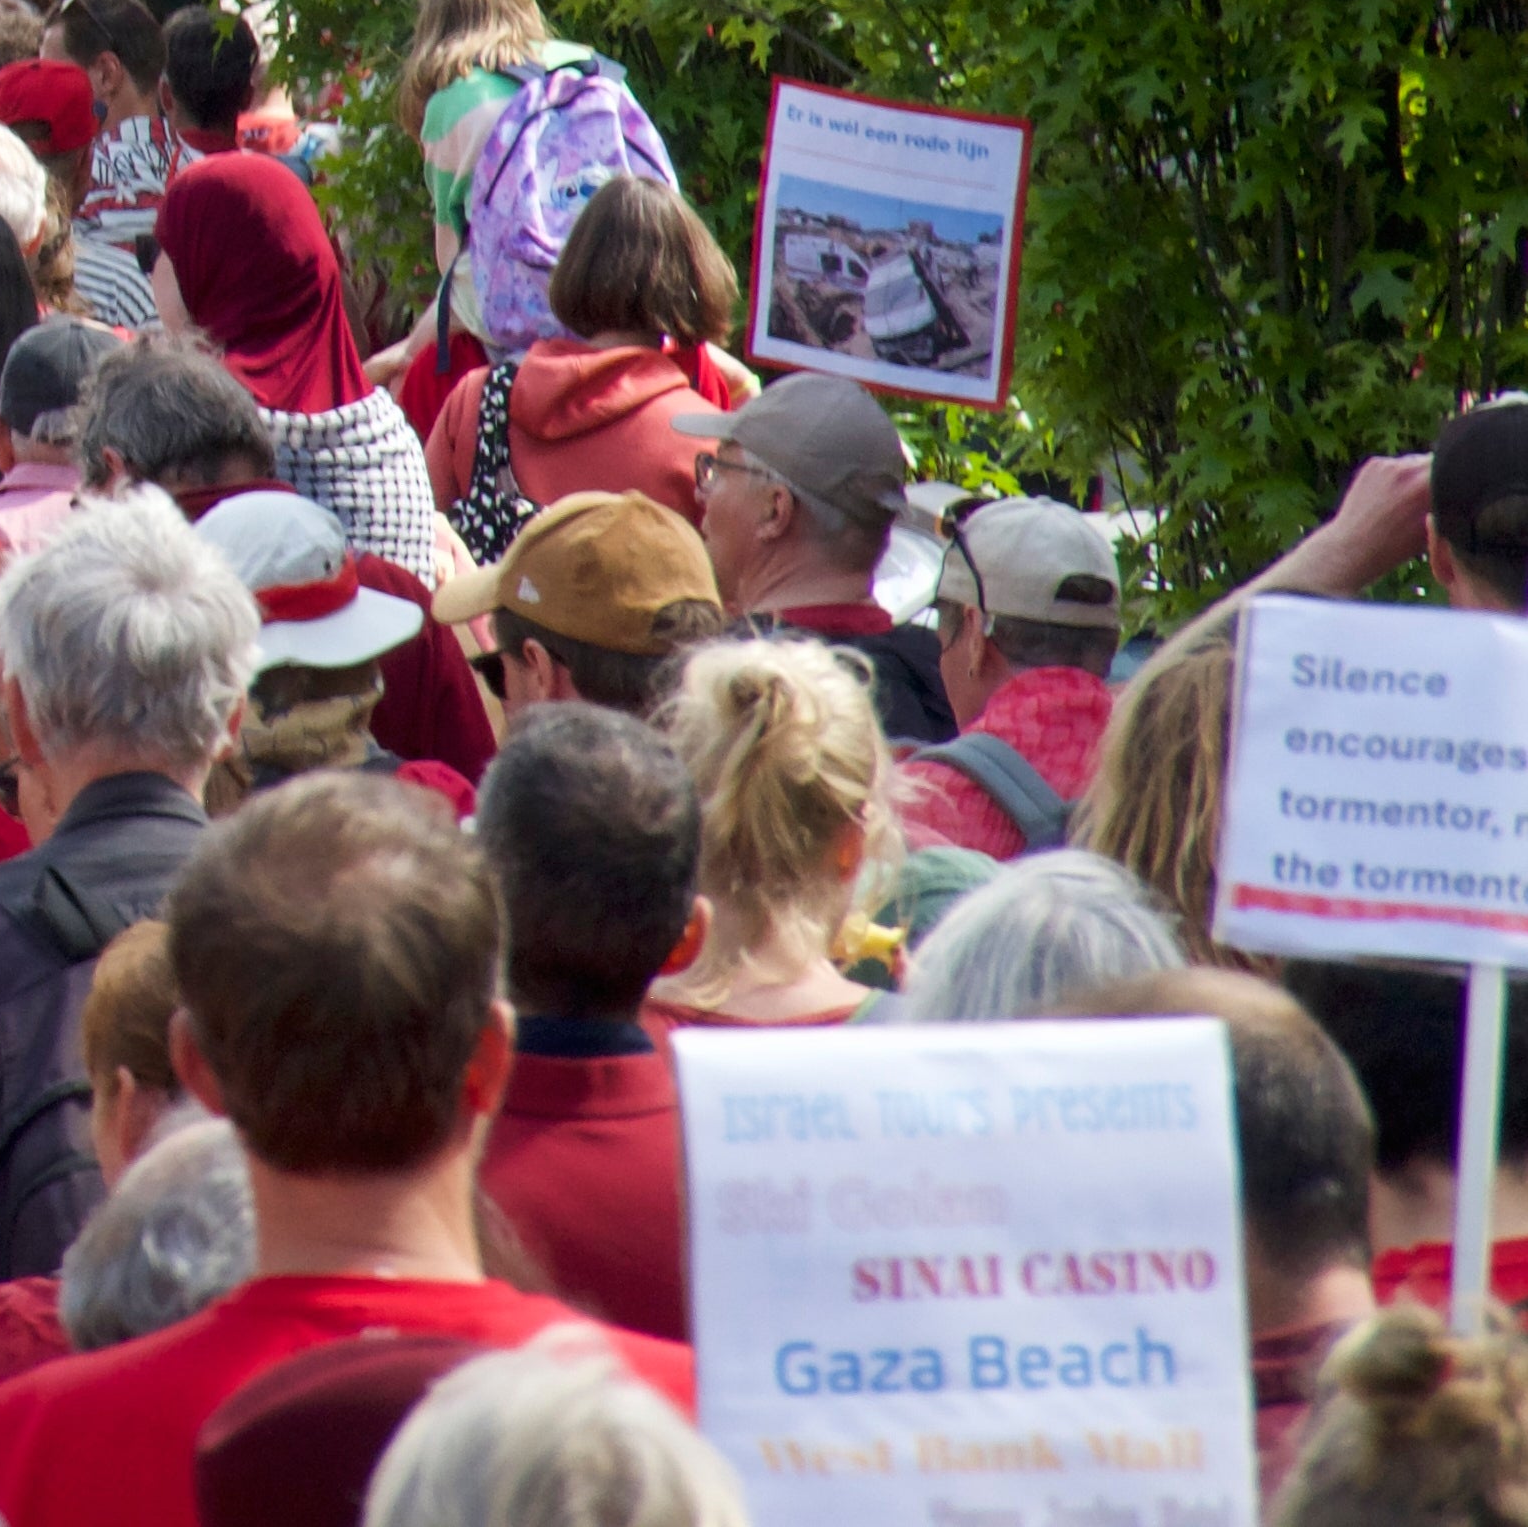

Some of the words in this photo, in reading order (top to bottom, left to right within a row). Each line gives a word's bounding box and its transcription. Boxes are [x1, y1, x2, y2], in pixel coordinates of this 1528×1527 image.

[786, 104, 804, 122] Er
[808, 109, 823, 128] is
[864, 125, 898, 145] een
[904, 133, 951, 153] rode
[957, 137, 990, 162] lijn
[1292, 653, 1450, 698] Silence
[1284, 726, 1528, 774] encourages
[1278, 787, 1501, 839] tormentor,
[1272, 852, 1340, 889] the
[851, 1252, 1004, 1303] SINAI
[1019, 1248, 1218, 1298] CASINO
[774, 1340, 946, 1397] Gaza
[967, 1326, 1177, 1391] Beach
[758, 1435, 896, 1479] West
[916, 1432, 1063, 1476] Bank
[1085, 1428, 1206, 1472] Mall
